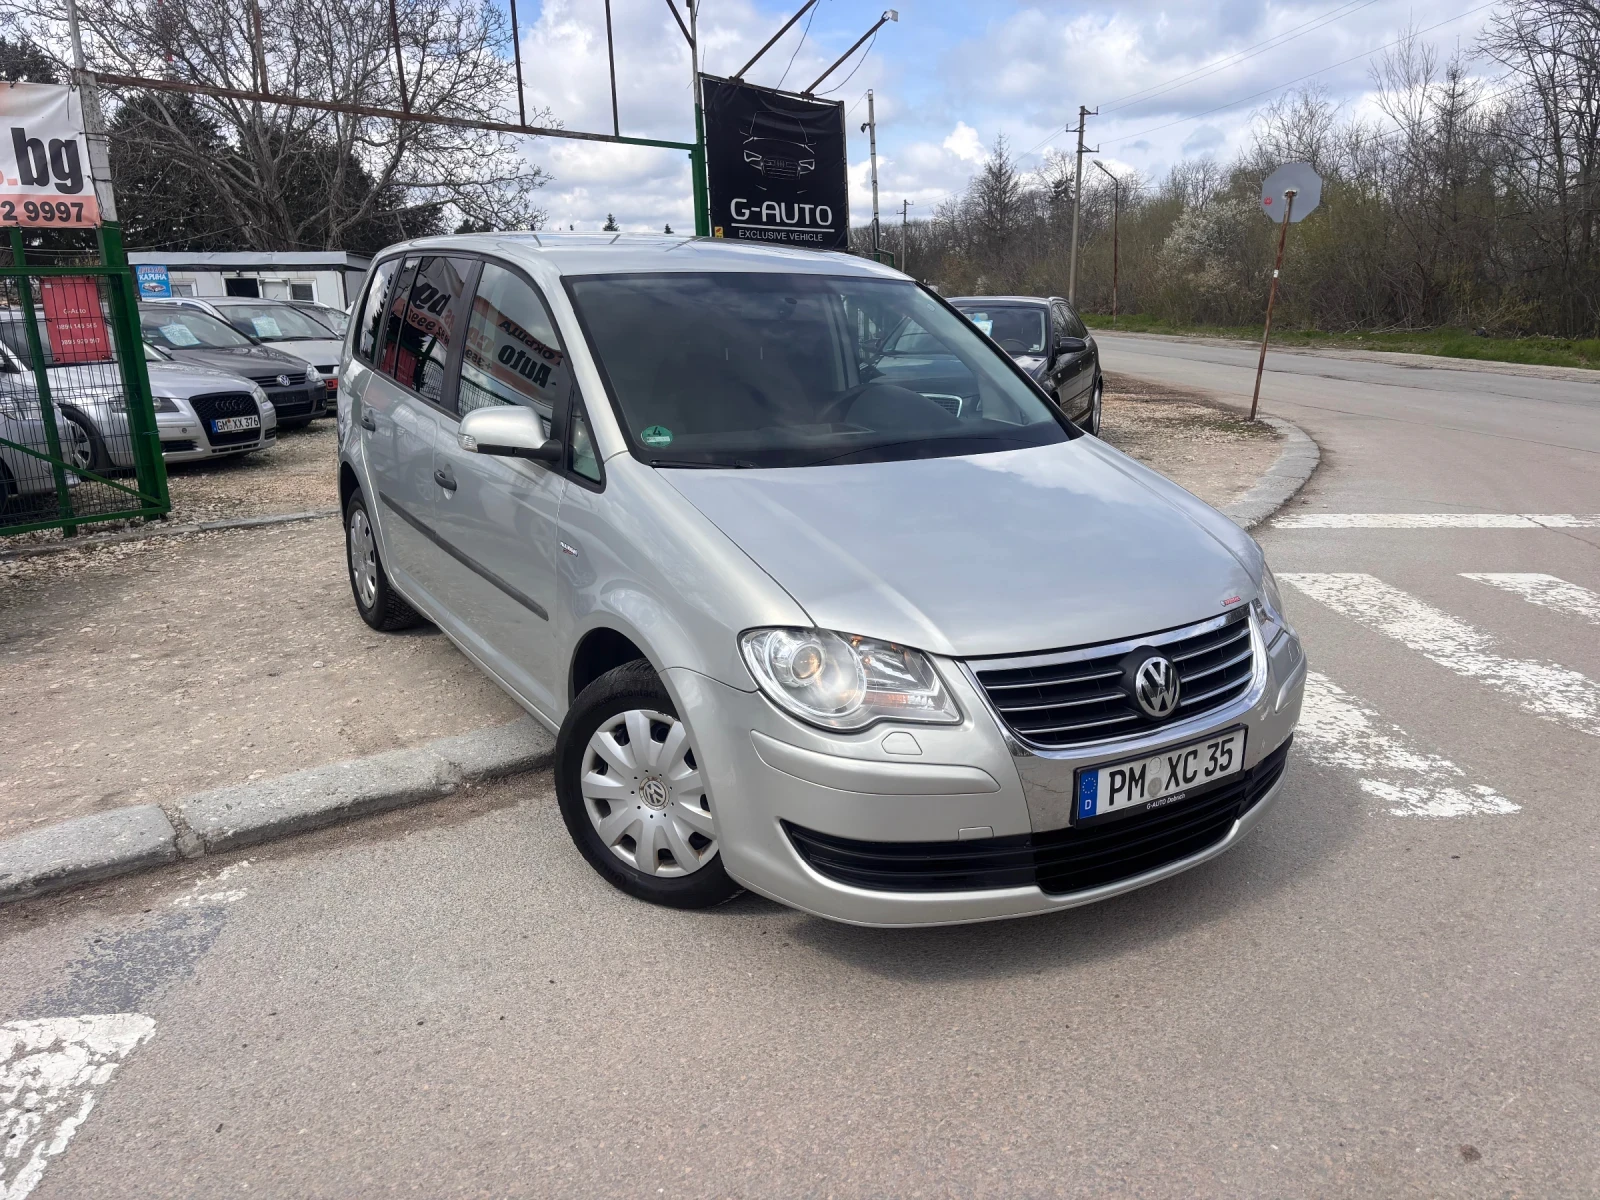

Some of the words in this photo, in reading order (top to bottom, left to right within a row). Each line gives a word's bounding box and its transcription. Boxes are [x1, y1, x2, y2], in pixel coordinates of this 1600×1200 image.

[0, 127, 84, 194] .bg
[23, 200, 84, 223] 9997
[730, 197, 833, 226] G-AUTO
[738, 229, 788, 241] EXCLUSIVE
[789, 232, 824, 242] VEHICLE
[216, 419, 229, 431] GM
[232, 418, 244, 429] XX
[244, 416, 259, 428] 376
[652, 426, 662, 437] 4
[1108, 763, 1147, 807] PM
[1164, 748, 1198, 791] XC
[1204, 736, 1235, 778] 35
[1084, 799, 1092, 810] D
[1146, 798, 1167, 810] G-AUTO
[1166, 792, 1186, 804] Dobrich
